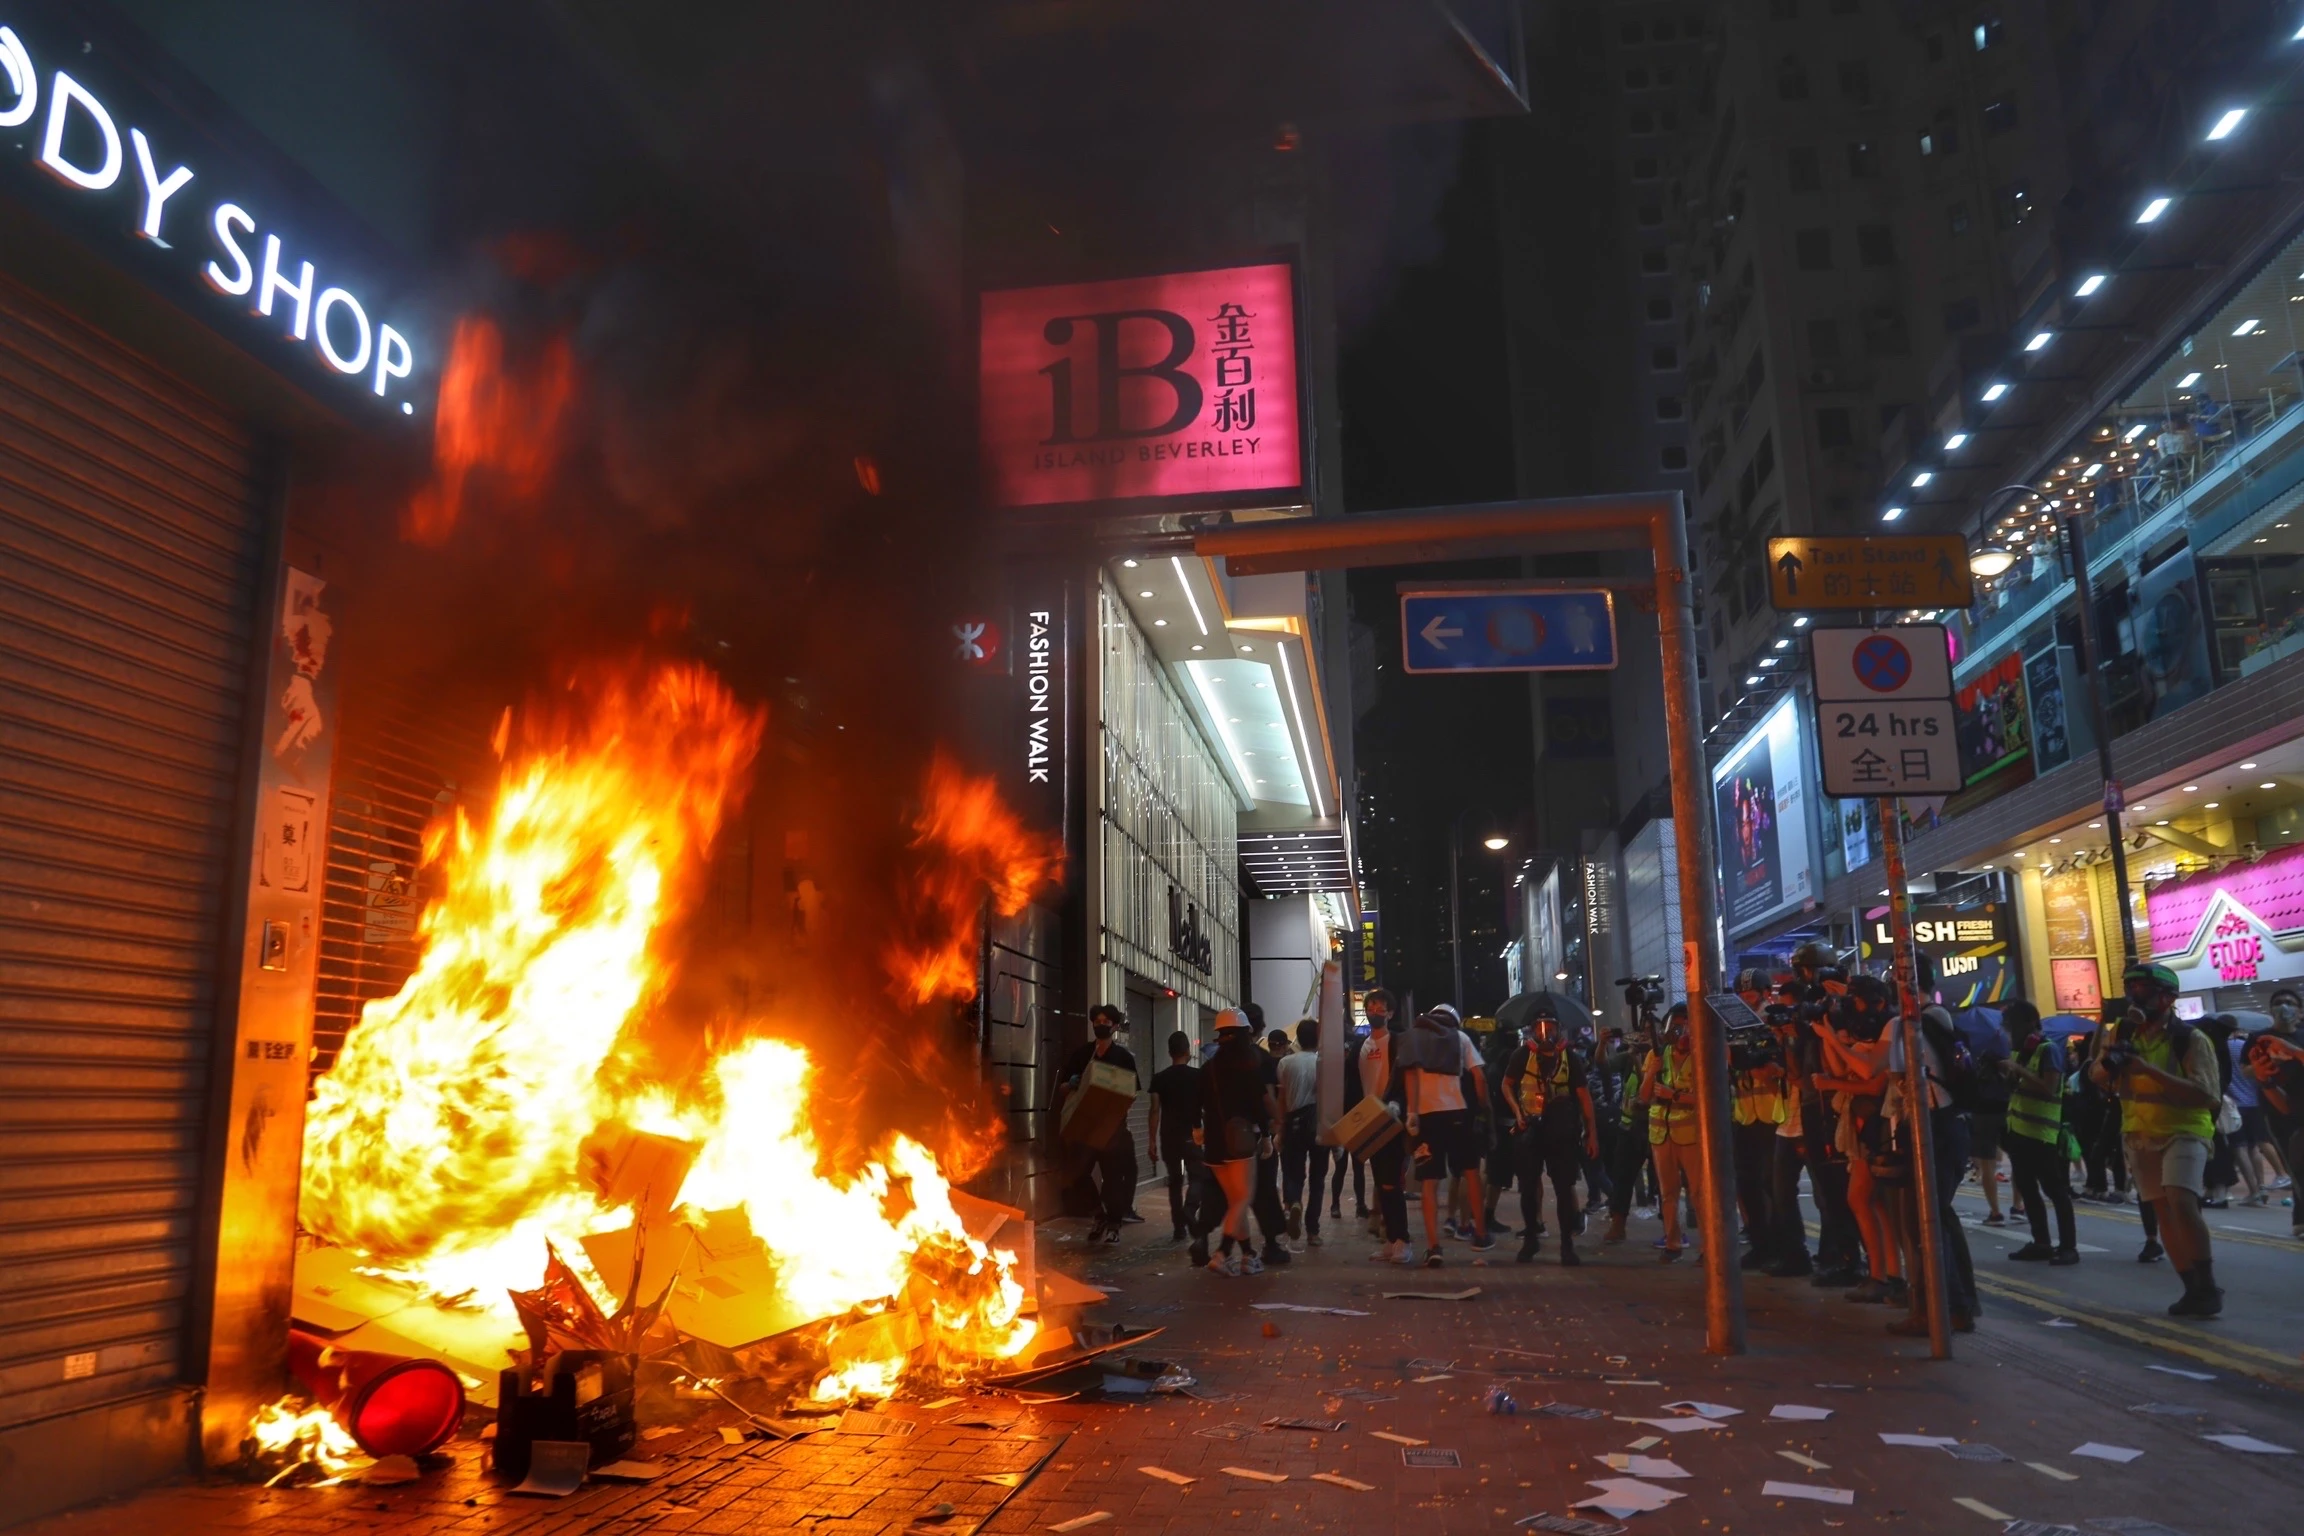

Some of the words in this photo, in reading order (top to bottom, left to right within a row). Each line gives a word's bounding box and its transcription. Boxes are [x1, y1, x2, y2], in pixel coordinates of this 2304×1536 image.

[1207, 302, 1257, 433] 金百利
[1034, 447, 1126, 470] ISLAND
[1139, 437, 1261, 462] BEVERLEY
[1809, 547, 1854, 565] Taxi
[1862, 547, 1927, 564] Stand
[1823, 571, 1917, 597] 的士站
[1029, 611, 1050, 712] FASHION
[1836, 712, 1880, 738] 24
[1890, 713, 1939, 737] hrs
[1029, 717, 1049, 783] WALK
[1851, 748, 1931, 782] 全日
[1586, 862, 1597, 905] FASHION
[1589, 907, 1598, 934] WALK
[1876, 920, 1956, 944] LSH
[1957, 920, 1993, 930] FRESH
[1363, 921, 1376, 982] IKEA
[2208, 936, 2264, 969] ETUDE
[2220, 963, 2258, 982] HOUSE
